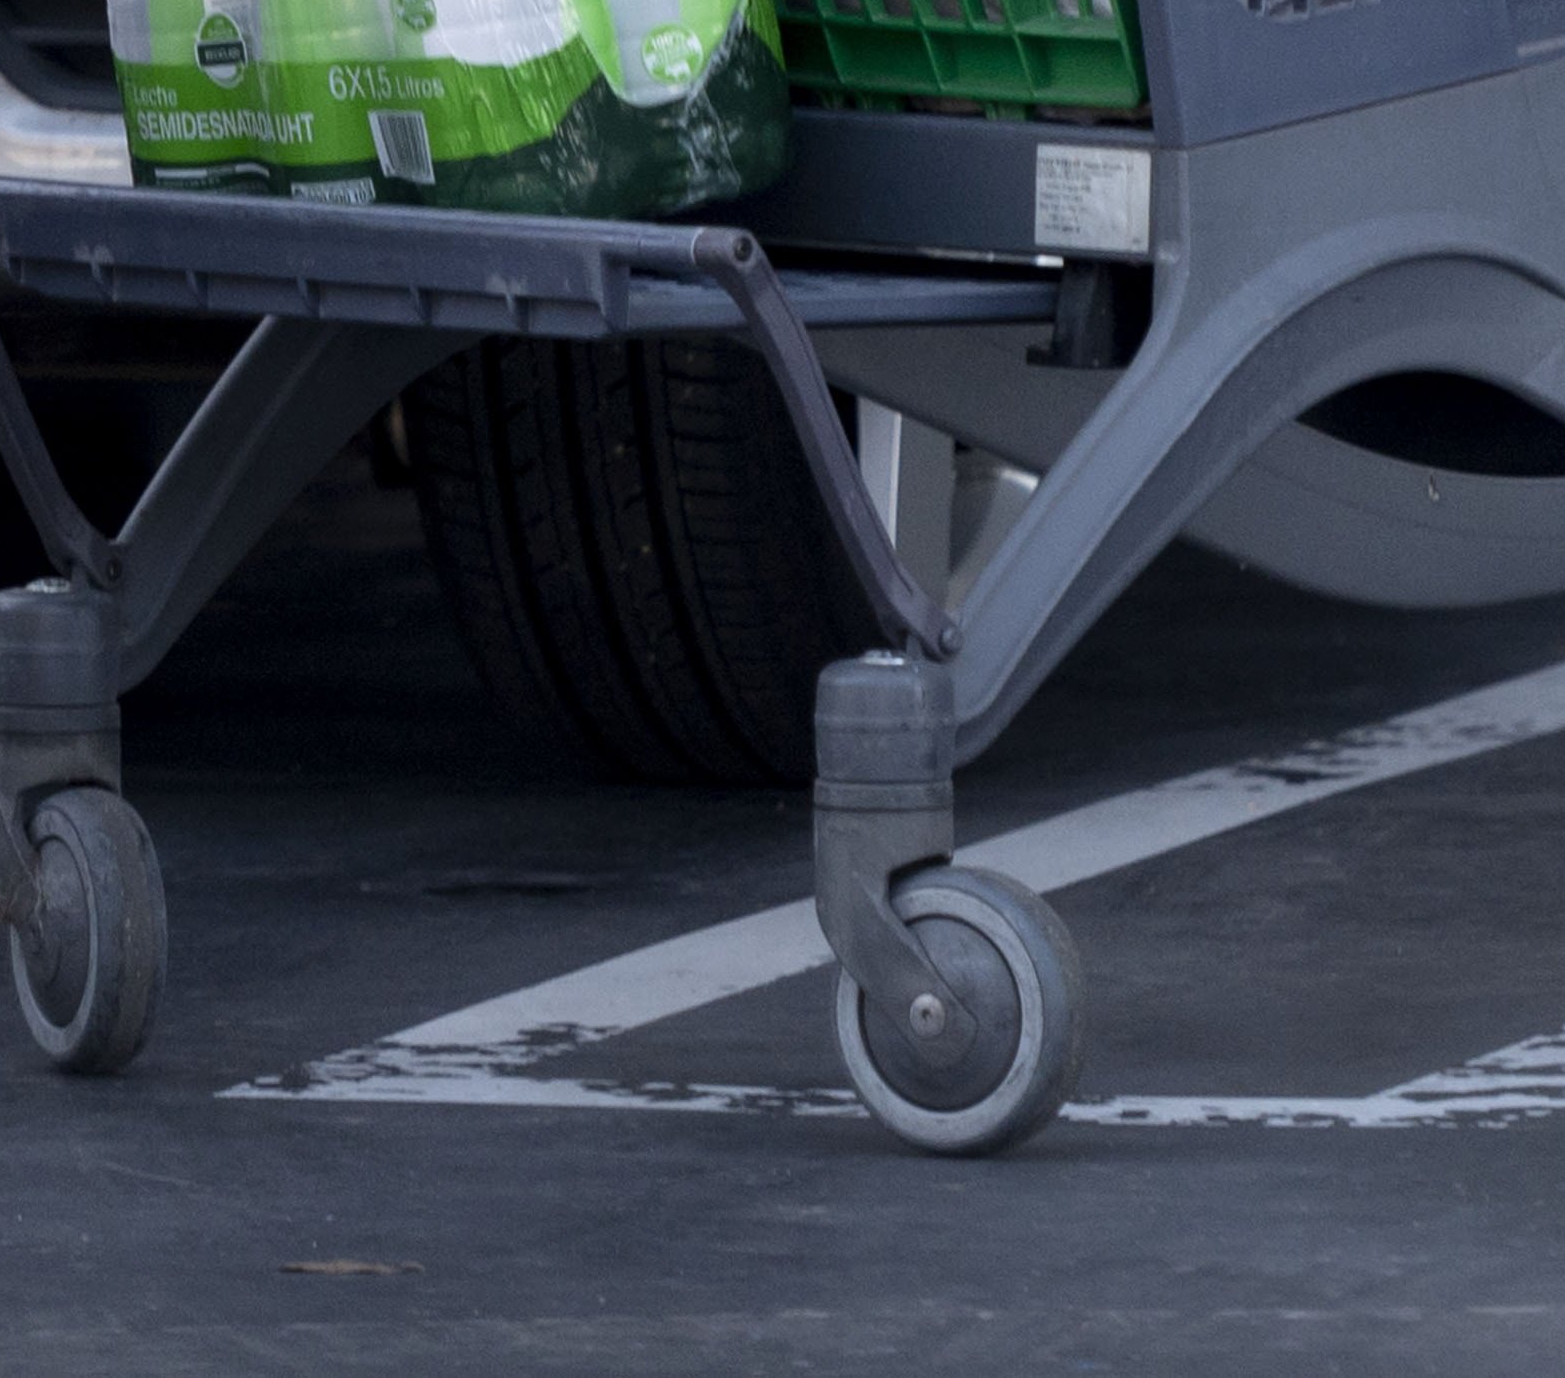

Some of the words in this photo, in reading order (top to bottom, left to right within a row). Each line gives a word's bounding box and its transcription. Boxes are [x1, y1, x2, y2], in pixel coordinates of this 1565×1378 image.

[133, 85, 178, 107] Leche
[137, 108, 276, 142] SEMIDESNATADA
[275, 111, 315, 144] UHT
